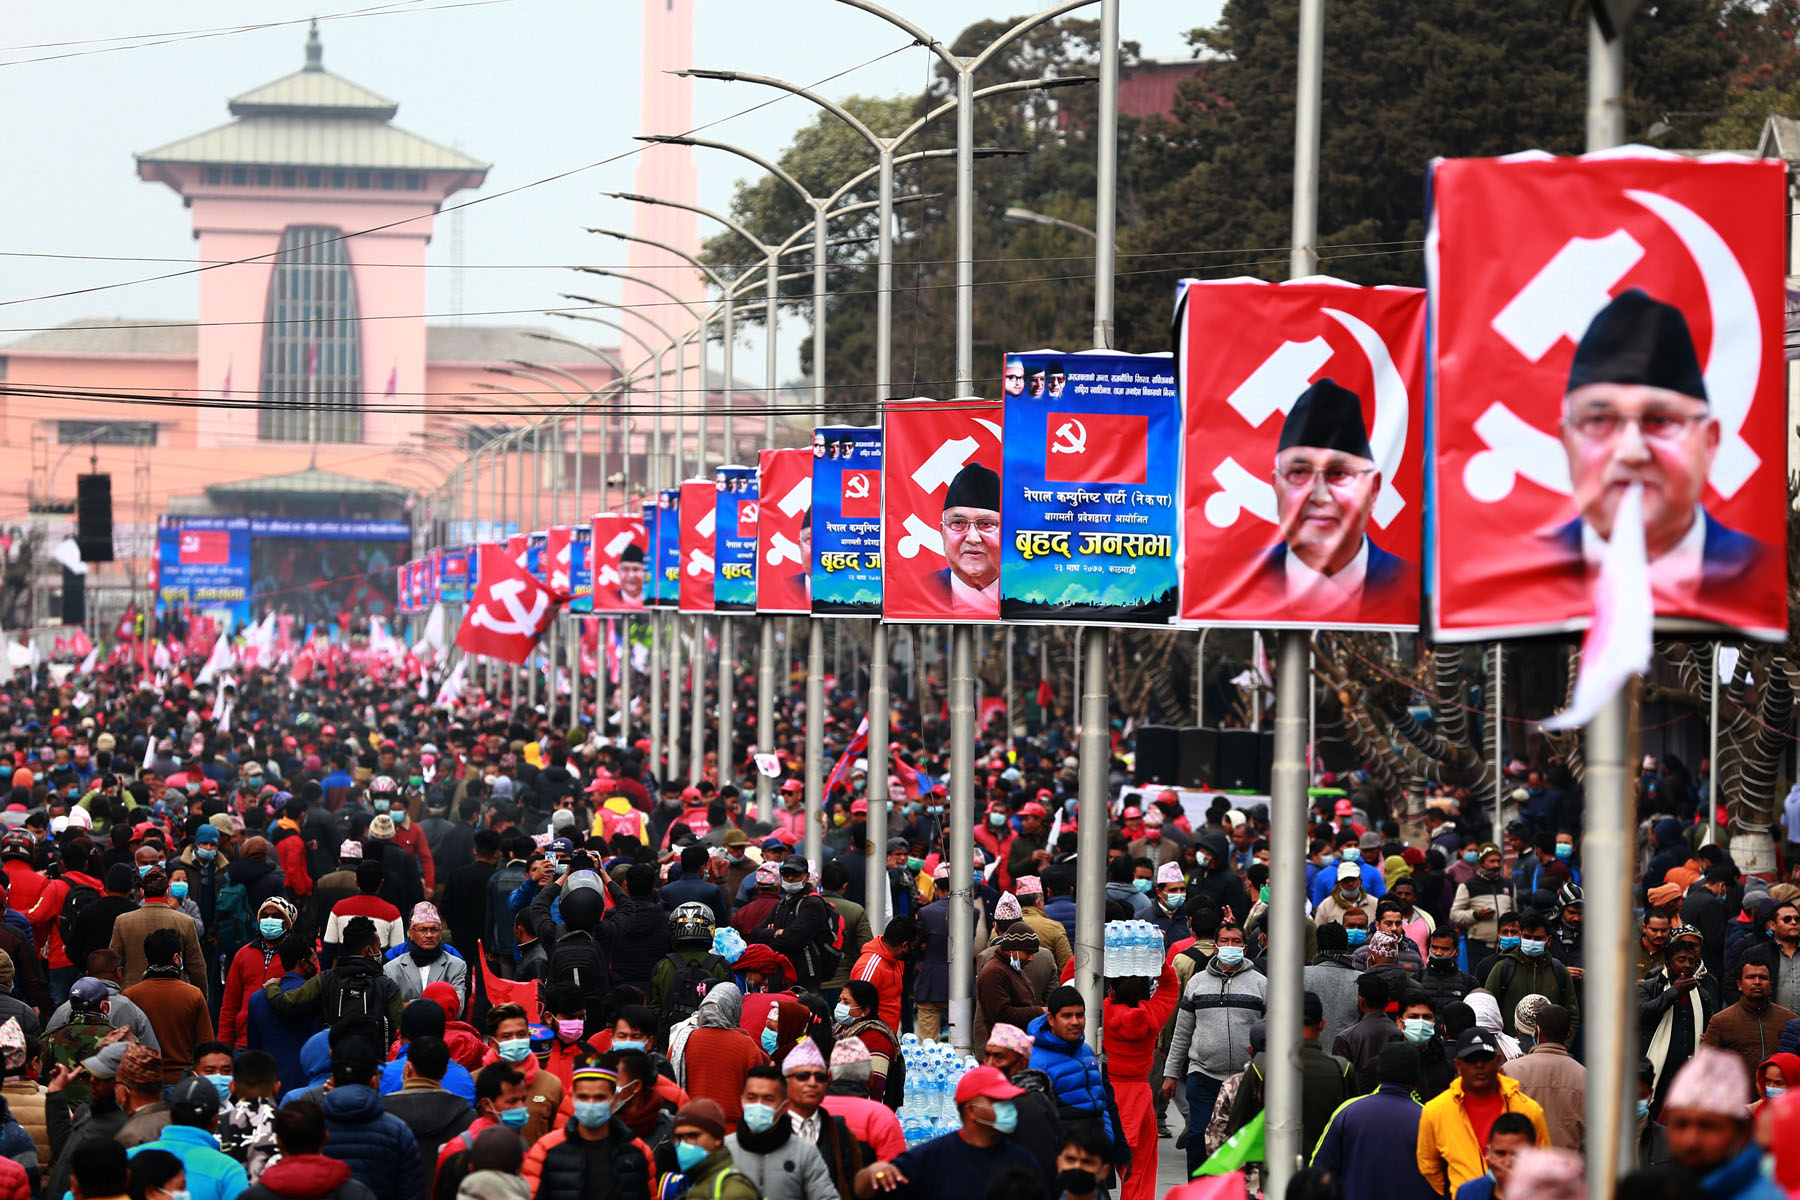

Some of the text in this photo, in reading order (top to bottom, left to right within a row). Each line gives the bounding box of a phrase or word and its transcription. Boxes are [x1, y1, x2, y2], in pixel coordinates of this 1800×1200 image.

[1023, 486, 1054, 502] नेपाल
[1056, 487, 1101, 507] कम्युनिष्ट
[1104, 489, 1128, 505] पार्टी
[825, 521, 847, 532] नेपाल
[1044, 510, 1074, 522] बागमती
[1115, 512, 1149, 524] आयोजित
[1015, 529, 1172, 560] बृहद जनसभा
[820, 551, 862, 573] बृहद
